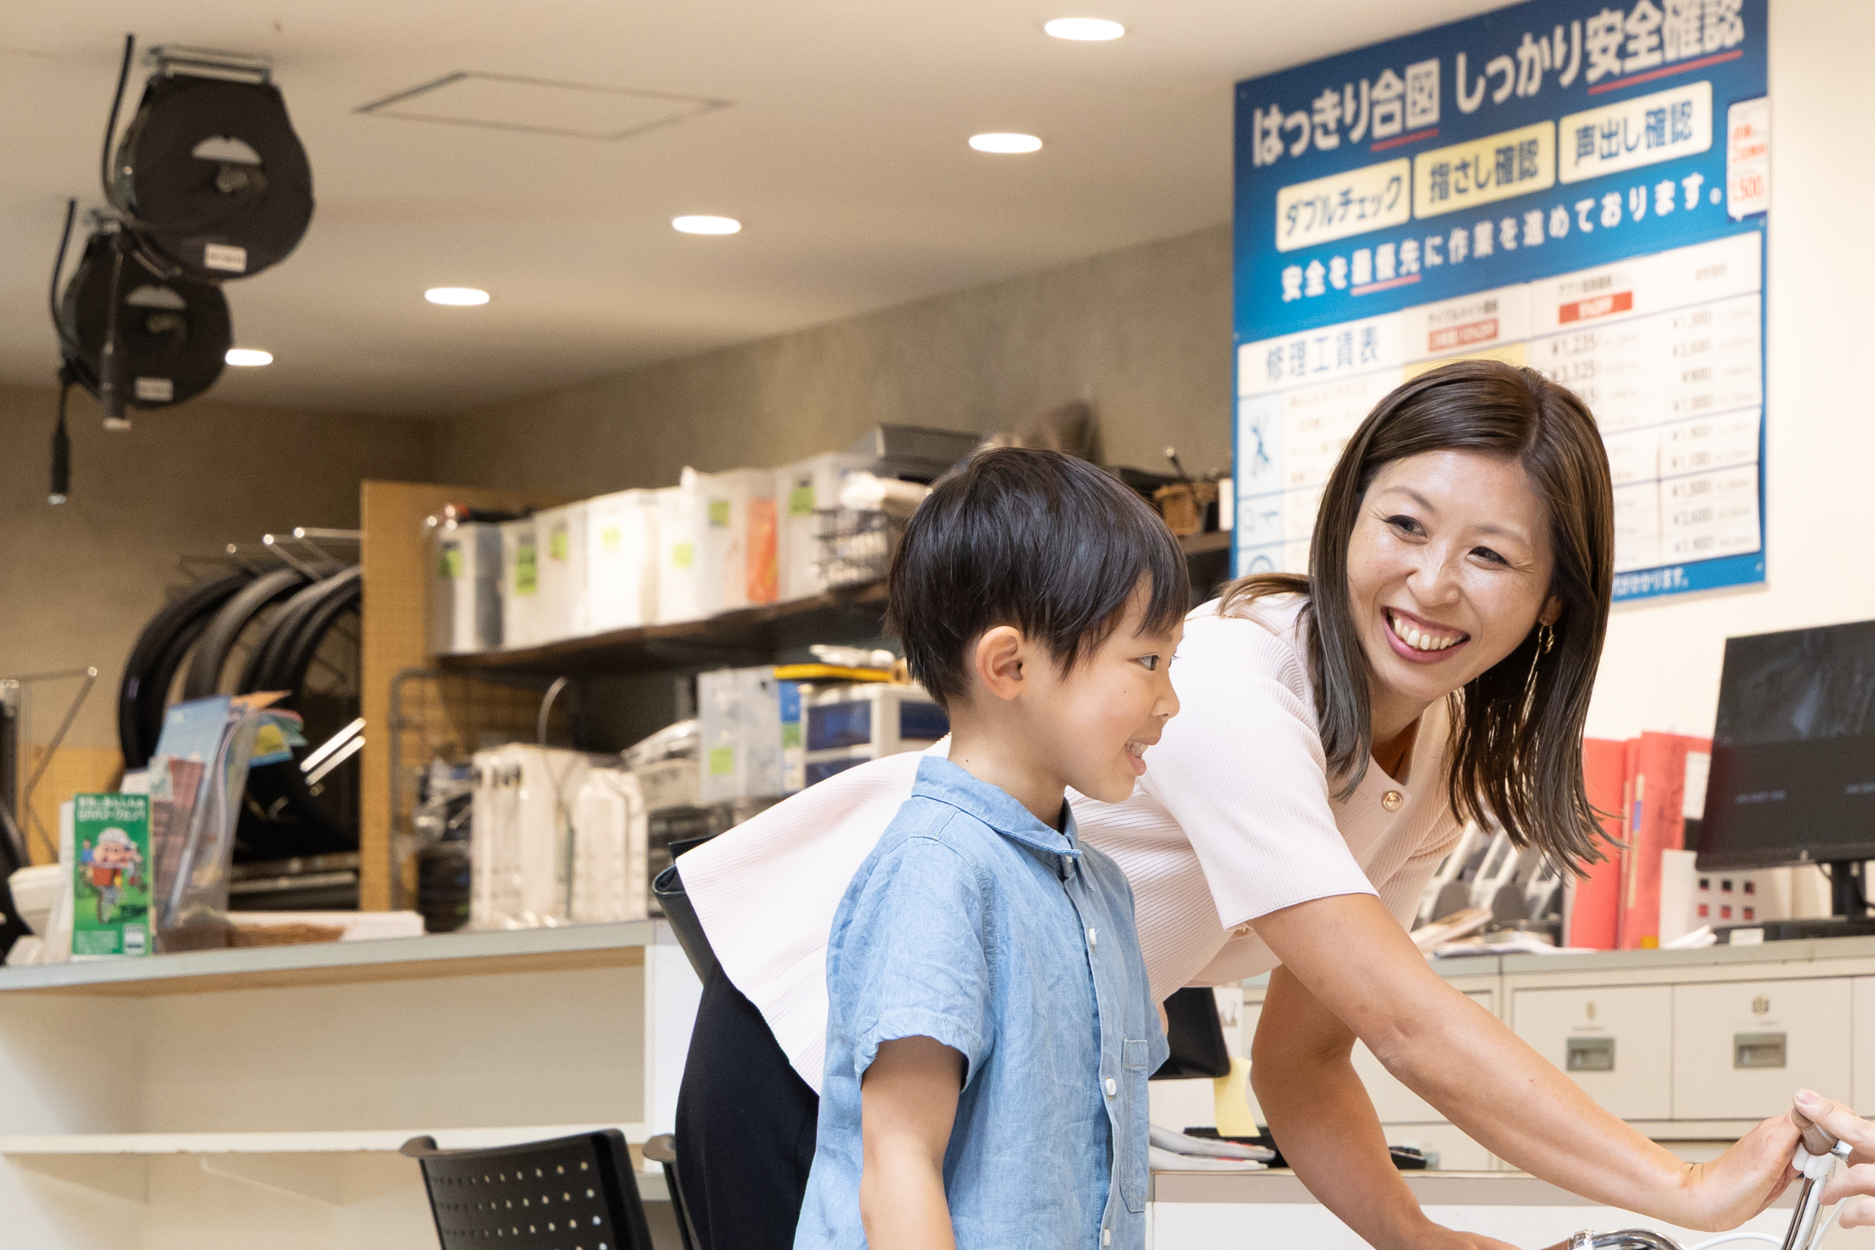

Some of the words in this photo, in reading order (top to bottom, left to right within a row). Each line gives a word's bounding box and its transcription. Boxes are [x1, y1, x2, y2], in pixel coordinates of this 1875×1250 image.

[1252, 58, 1440, 167] はっきり合図
[1455, 0, 1747, 114] しっかり安全確認
[1574, 96, 1694, 167] 声出し確認
[1429, 137, 1539, 203] 指さし確認
[1282, 171, 1721, 303] 安全を最優先に作業を進めております。
[1284, 173, 1403, 239] ダブルチェック
